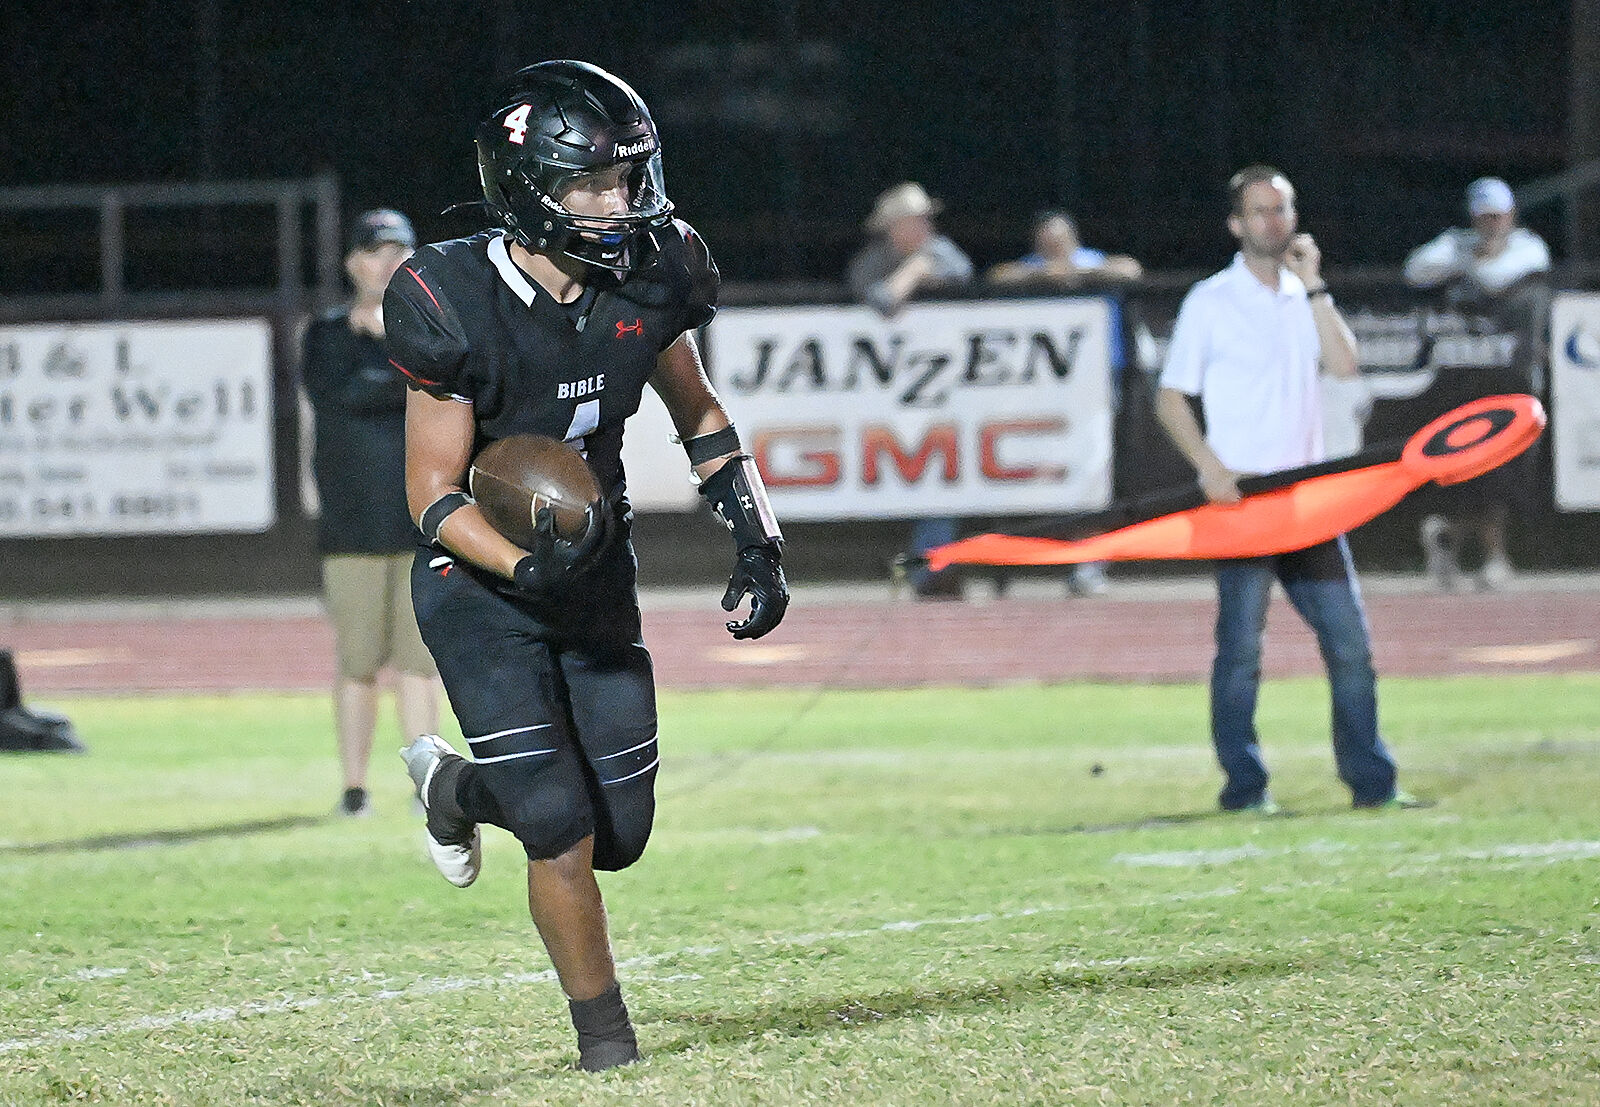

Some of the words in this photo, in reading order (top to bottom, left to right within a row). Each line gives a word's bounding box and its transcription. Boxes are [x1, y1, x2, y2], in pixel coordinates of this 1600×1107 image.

[502, 104, 533, 145] 4
[556, 373, 606, 400] BIBLE
[730, 327, 1084, 408] JANZEN
[110, 377, 256, 420] Well
[752, 412, 1070, 488] GMC
